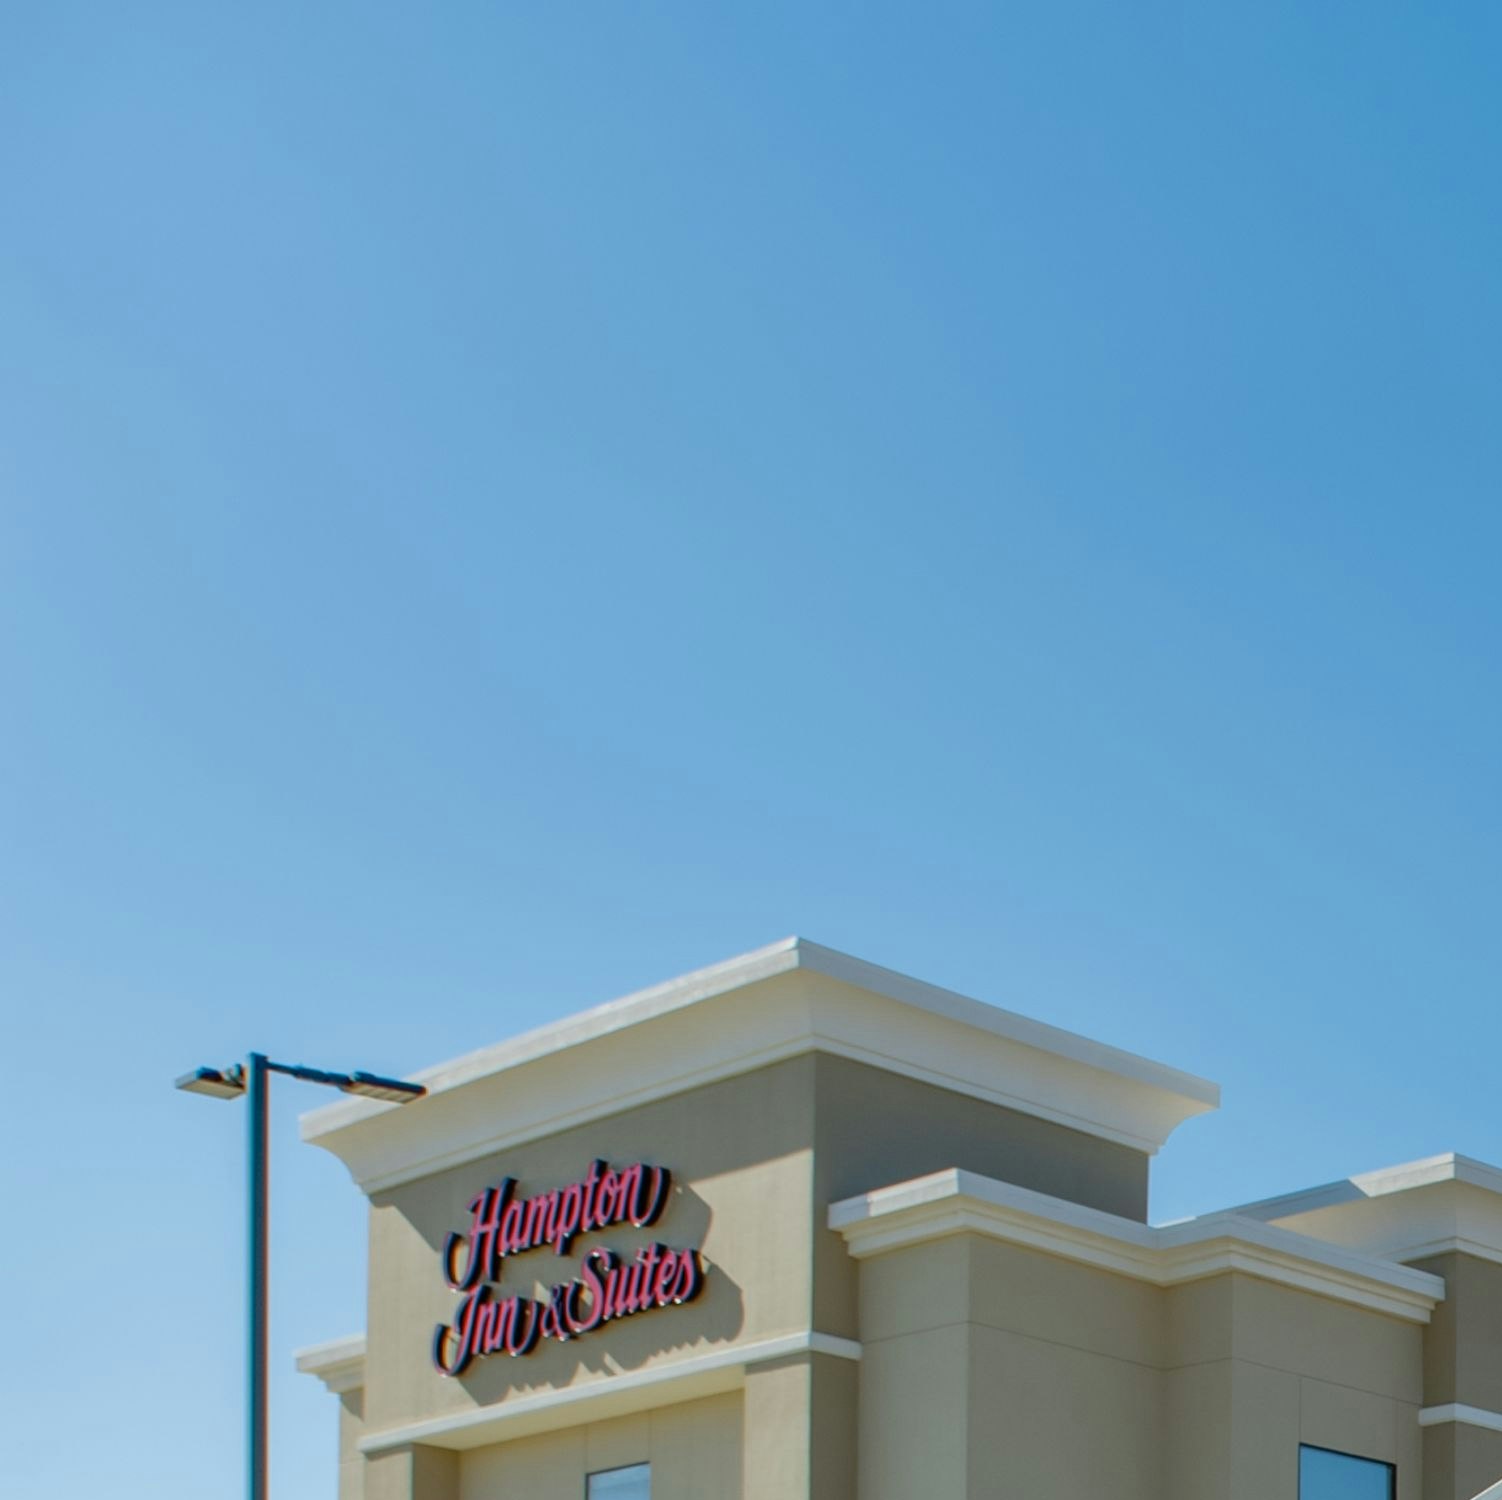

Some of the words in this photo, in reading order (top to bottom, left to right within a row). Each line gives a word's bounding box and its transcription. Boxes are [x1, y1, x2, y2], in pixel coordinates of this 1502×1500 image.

[442, 1158, 671, 1292] Hampton
[432, 1283, 542, 1377] Inn
[565, 1242, 705, 1333] Suites
